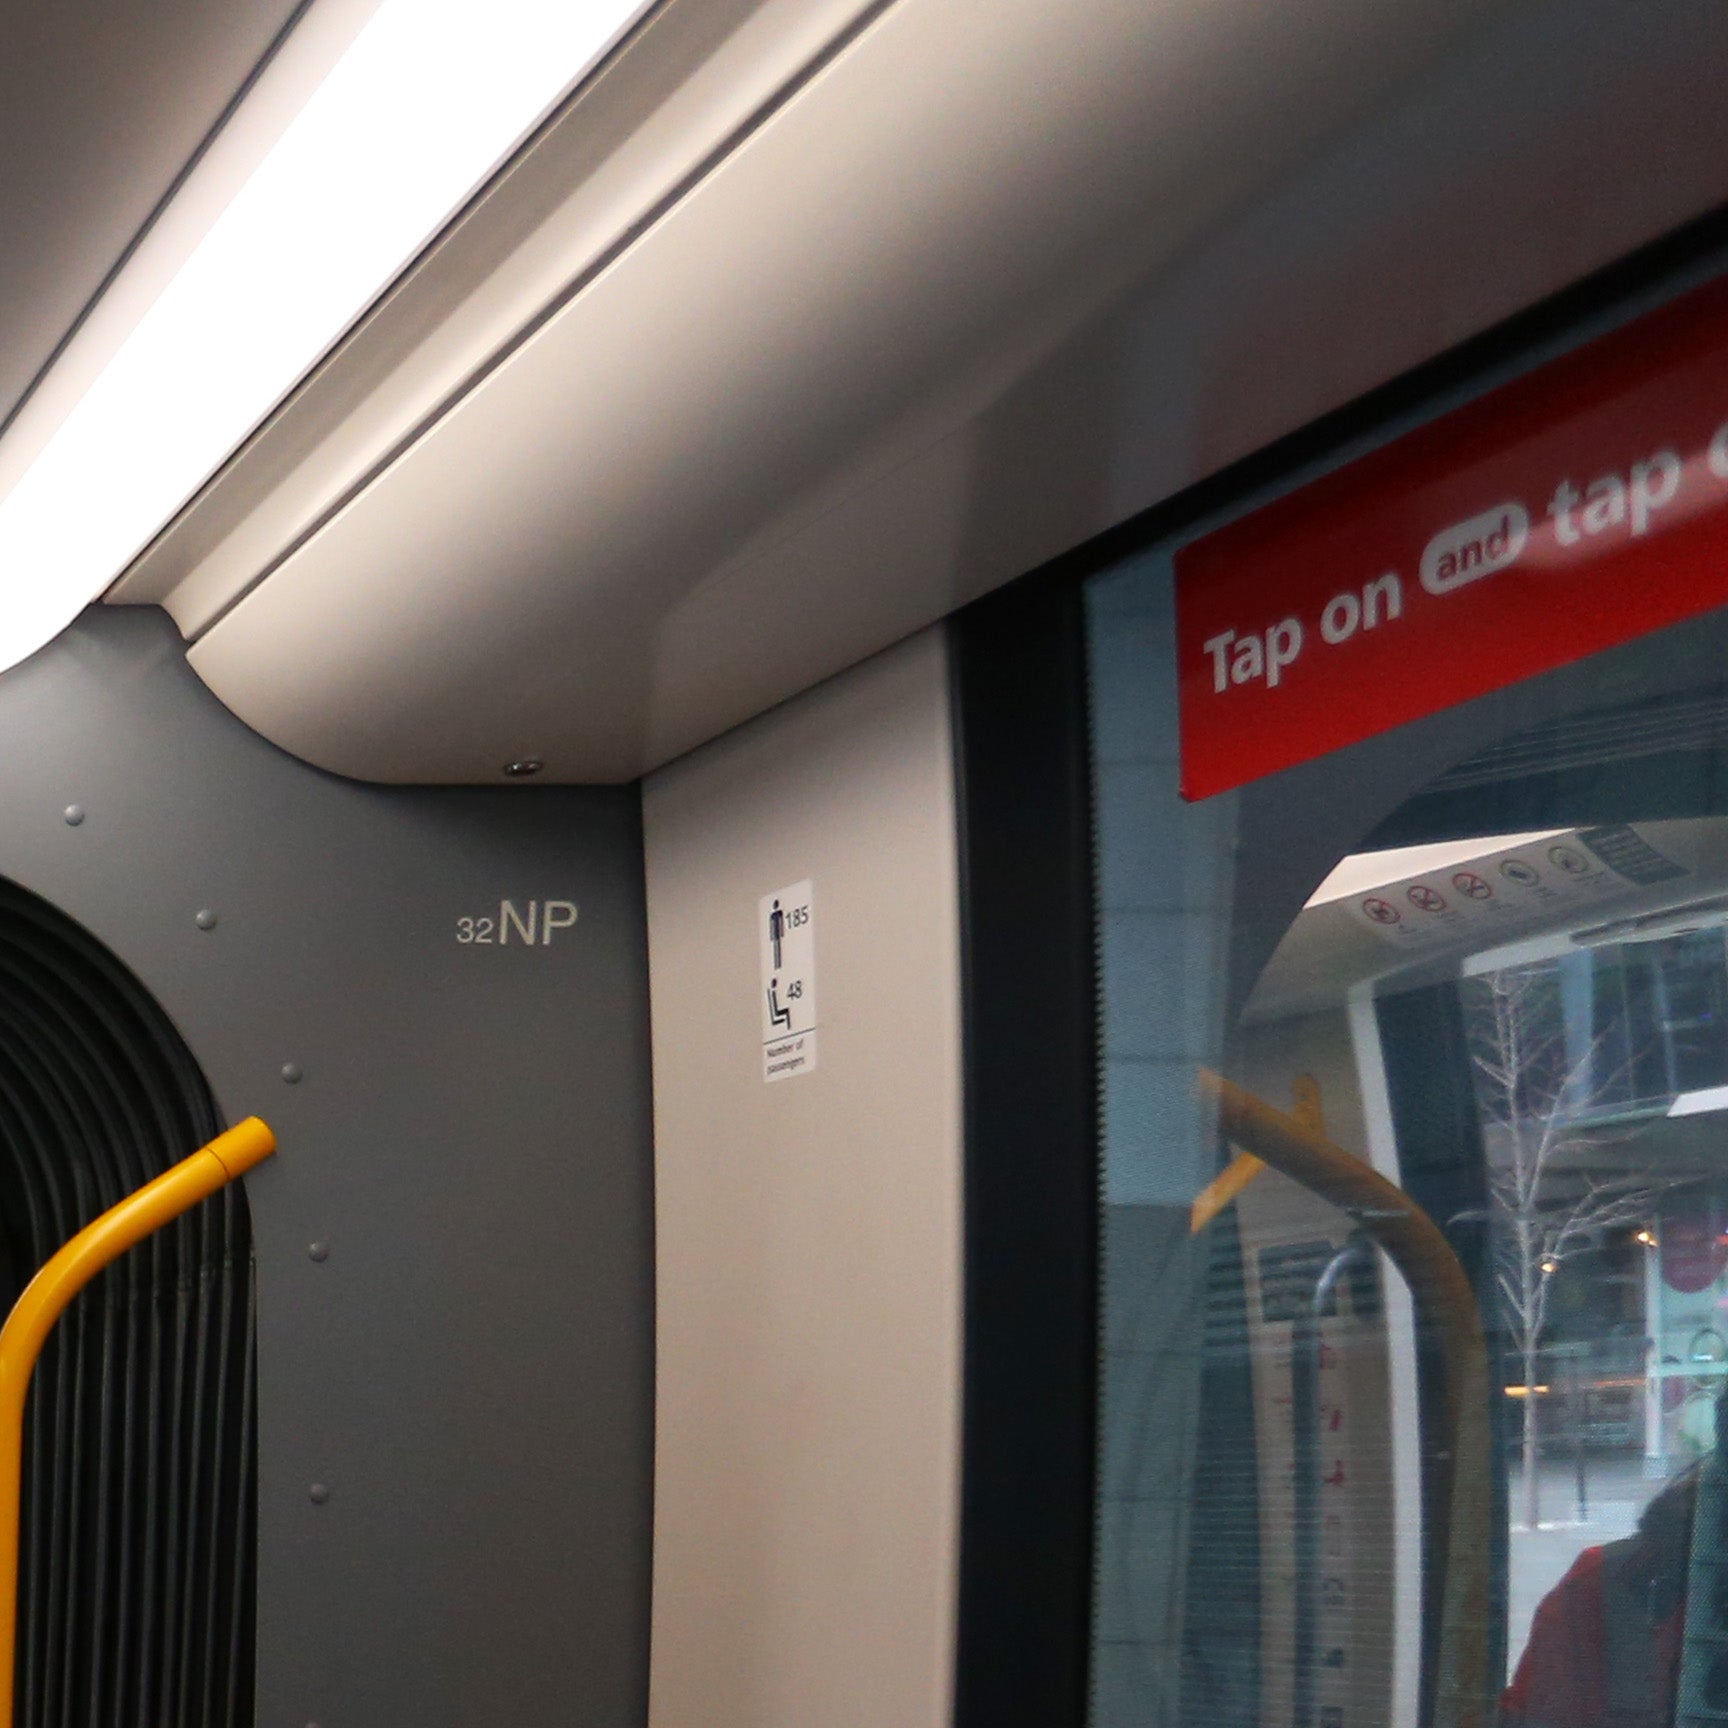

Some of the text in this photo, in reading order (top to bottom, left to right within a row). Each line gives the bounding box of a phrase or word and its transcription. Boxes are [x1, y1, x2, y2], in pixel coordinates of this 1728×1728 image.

[1203, 615, 1303, 694] Tap
[1320, 571, 1404, 645] on
[1437, 516, 1510, 582] and
[1546, 449, 1681, 547] tap
[784, 905, 809, 930] 185
[786, 980, 803, 1001] 48
